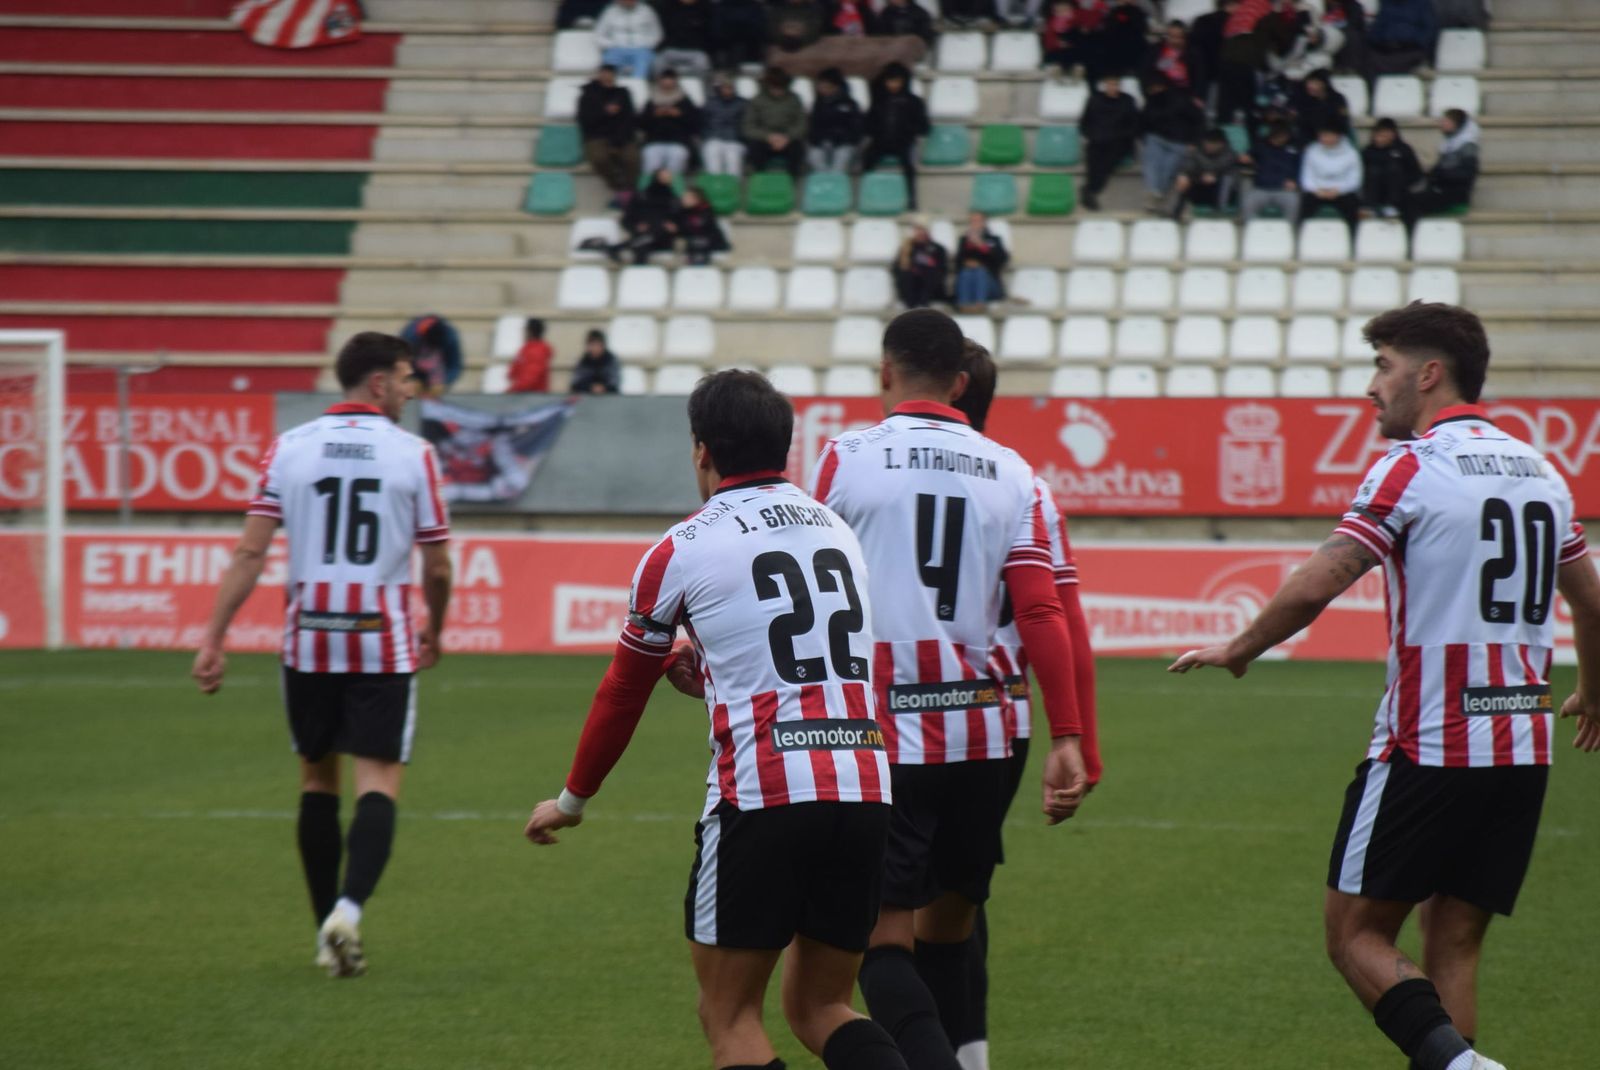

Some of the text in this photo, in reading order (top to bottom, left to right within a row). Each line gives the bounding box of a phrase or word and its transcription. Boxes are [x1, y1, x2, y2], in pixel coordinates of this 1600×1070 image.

[95, 406, 261, 443] BERNAL
[907, 447, 998, 481] ATHUMAN
[1313, 404, 1600, 477] ZAORA
[313, 476, 381, 566] 16
[735, 503, 834, 535] J. SANCHO
[915, 492, 967, 622] 4
[1480, 497, 1556, 626] 20
[752, 547, 869, 685] 22
